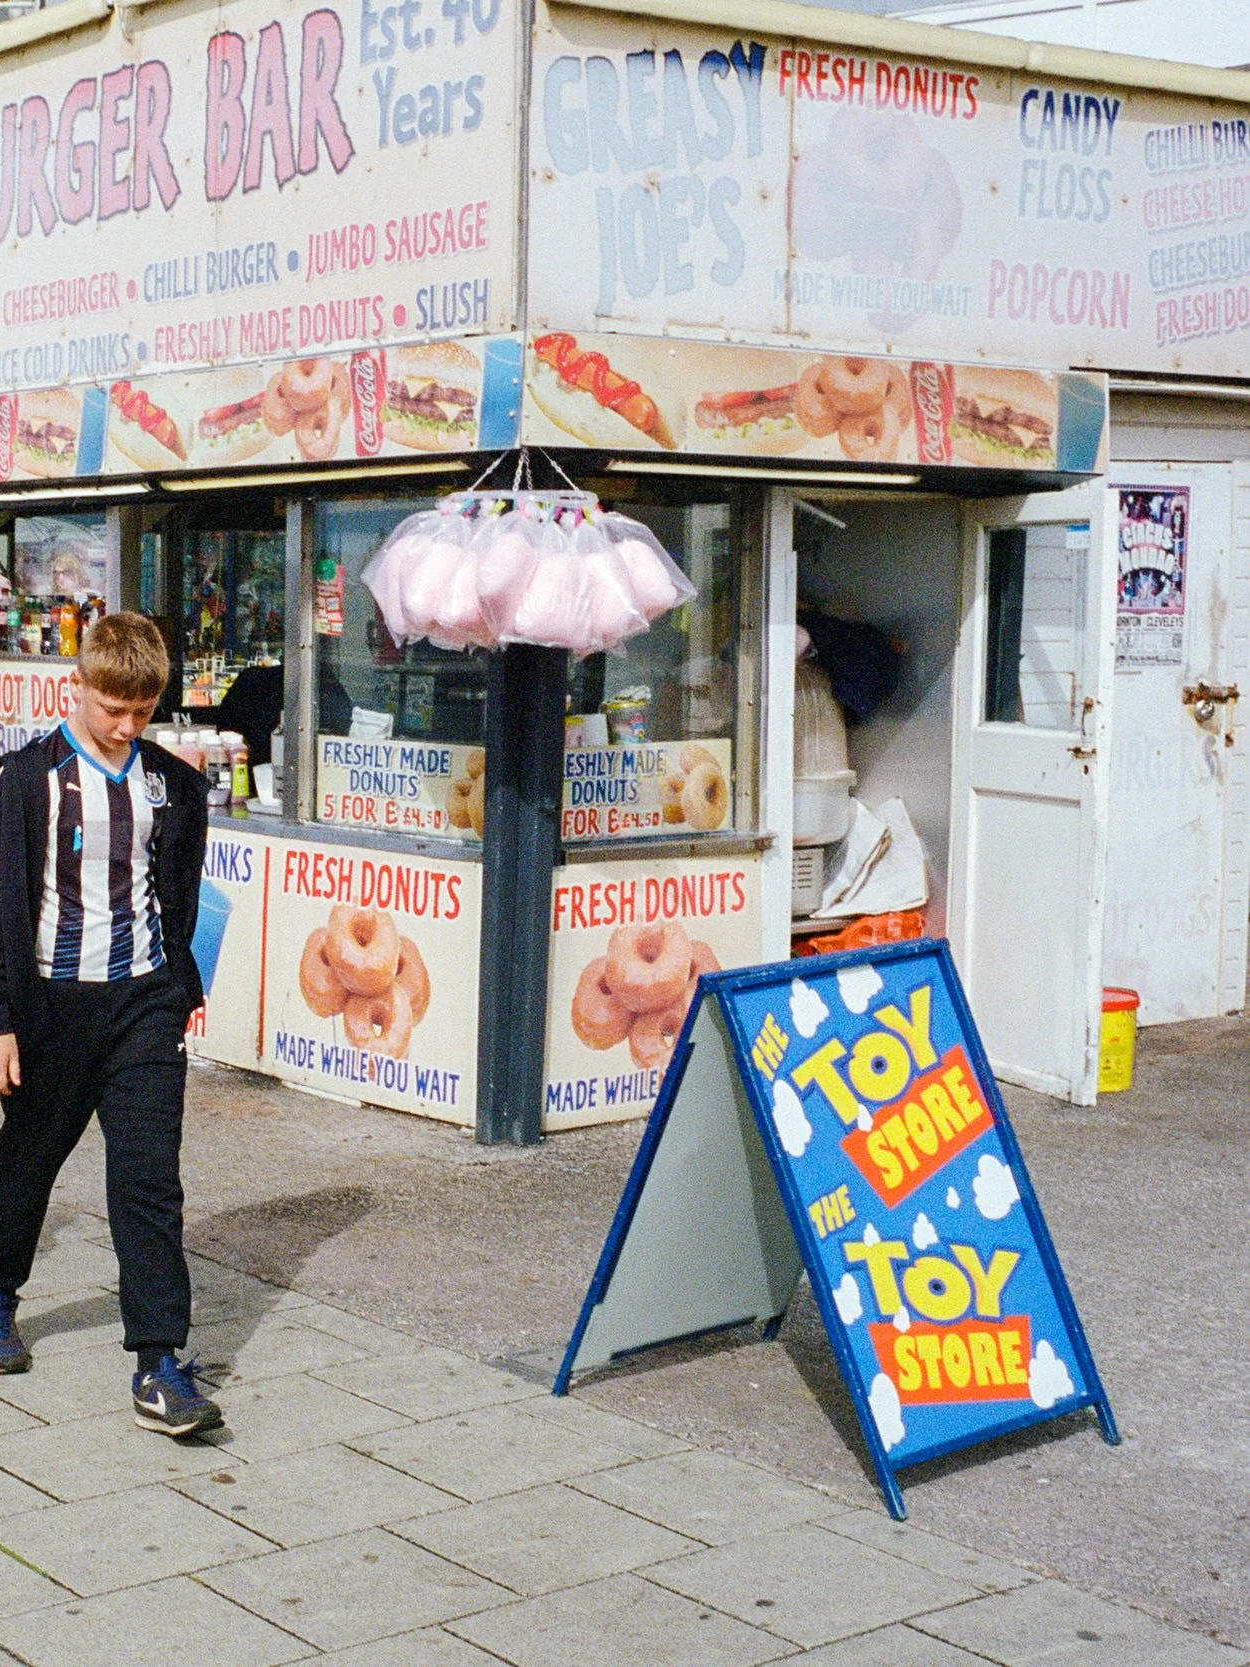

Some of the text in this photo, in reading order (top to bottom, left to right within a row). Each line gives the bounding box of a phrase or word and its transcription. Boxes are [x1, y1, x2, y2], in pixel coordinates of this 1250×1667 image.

[360, 0, 435, 64] Est.
[203, 8, 356, 202] BAR
[372, 66, 485, 149] Years
[544, 39, 768, 176] GREASY
[779, 49, 980, 121] FRESH DONUTS
[1020, 88, 1121, 157] CANDY
[1144, 124, 1210, 170] CHILLI
[1018, 158, 1113, 224] FLOSS
[1142, 180, 1213, 229] CHEESE
[3, 271, 120, 327] CHEESEBURGER
[143, 255, 199, 303] CHILLI
[206, 241, 279, 294] BURGER
[305, 222, 377, 283] JUMBO
[383, 200, 489, 263] SAUSAGE
[595, 174, 746, 316] JOE'S
[831, 274, 884, 310] WHILE
[892, 276, 927, 313] YOU
[931, 283, 973, 318] WAIT
[987, 258, 1131, 329] POPCORN
[1155, 291, 1217, 341] FRESH
[24, 342, 62, 382] COLD
[68, 332, 130, 377] DRINKS
[154, 315, 232, 364] FRESHLY
[239, 306, 292, 354] MADE
[299, 294, 384, 347] DONUTS
[415, 278, 489, 331] SLUSH
[323, 741, 450, 774] FRESHLY MADE
[350, 768, 418, 798] DONUTS
[621, 748, 666, 775] MADE
[323, 794, 335, 818] 5
[341, 795, 378, 823] FOR
[562, 808, 600, 837] FOR
[571, 779, 639, 806] DONUTS
[283, 850, 462, 921] FRESH DONUTS
[553, 871, 746, 932] FRESH DONUTS
[275, 1031, 461, 1106] MADE WHILE YOU WAIT
[751, 1011, 789, 1083] THE
[790, 985, 933, 1126] TOY
[545, 1070, 659, 1113] MADE WHILE
[866, 1065, 984, 1191] STORE
[808, 1183, 856, 1240] THE
[842, 1241, 1021, 1322] TOY
[892, 1331, 1029, 1392] STORE
